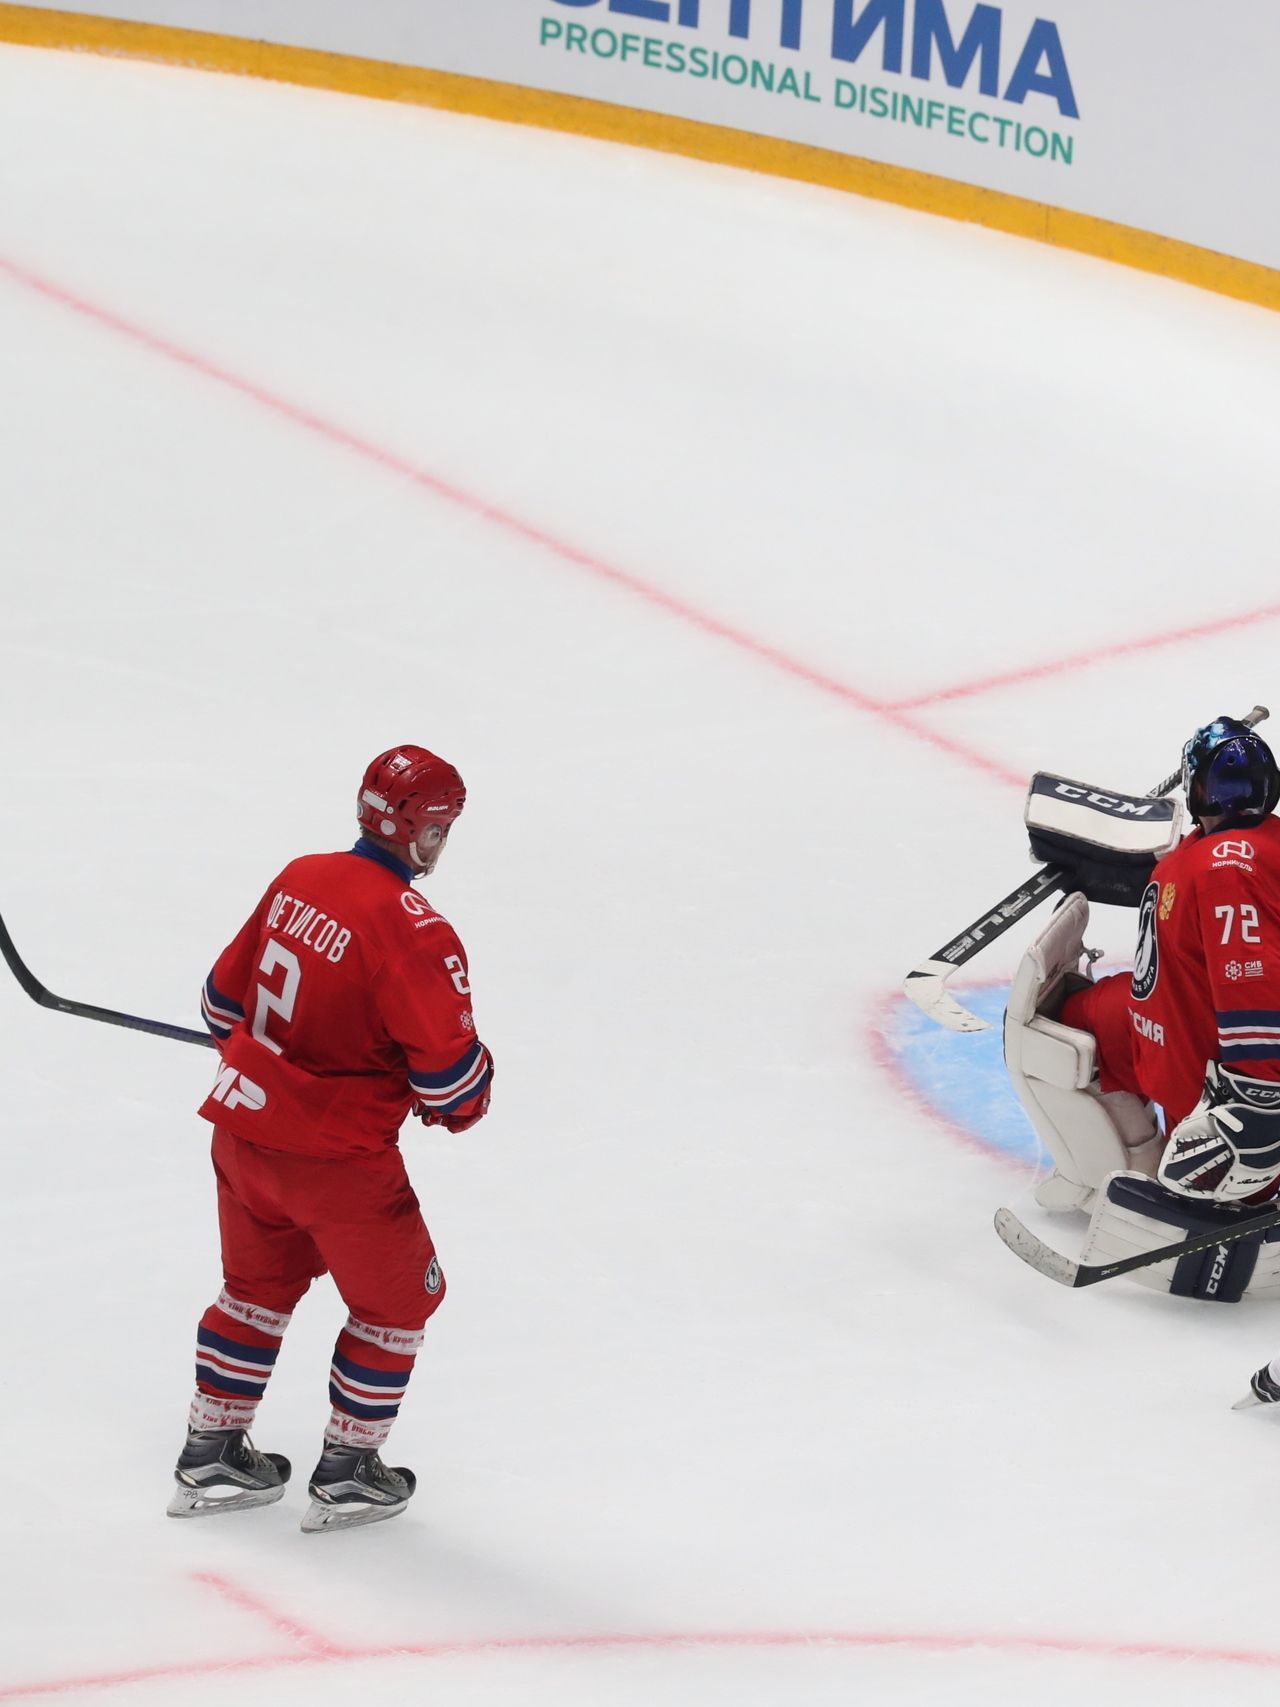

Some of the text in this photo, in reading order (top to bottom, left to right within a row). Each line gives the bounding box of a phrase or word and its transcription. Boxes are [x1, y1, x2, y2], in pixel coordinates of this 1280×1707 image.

[539, 18, 1074, 165] PROFESSIONAL DISINFECTION
[1055, 782, 1153, 816] CCM
[267, 891, 351, 963] ФЕТИСОВ
[1214, 903, 1261, 945] 72
[252, 937, 301, 1055] 2
[444, 954, 471, 995] 2
[1128, 1007, 1164, 1047] СИЯ
[1206, 1244, 1229, 1294] CCM
